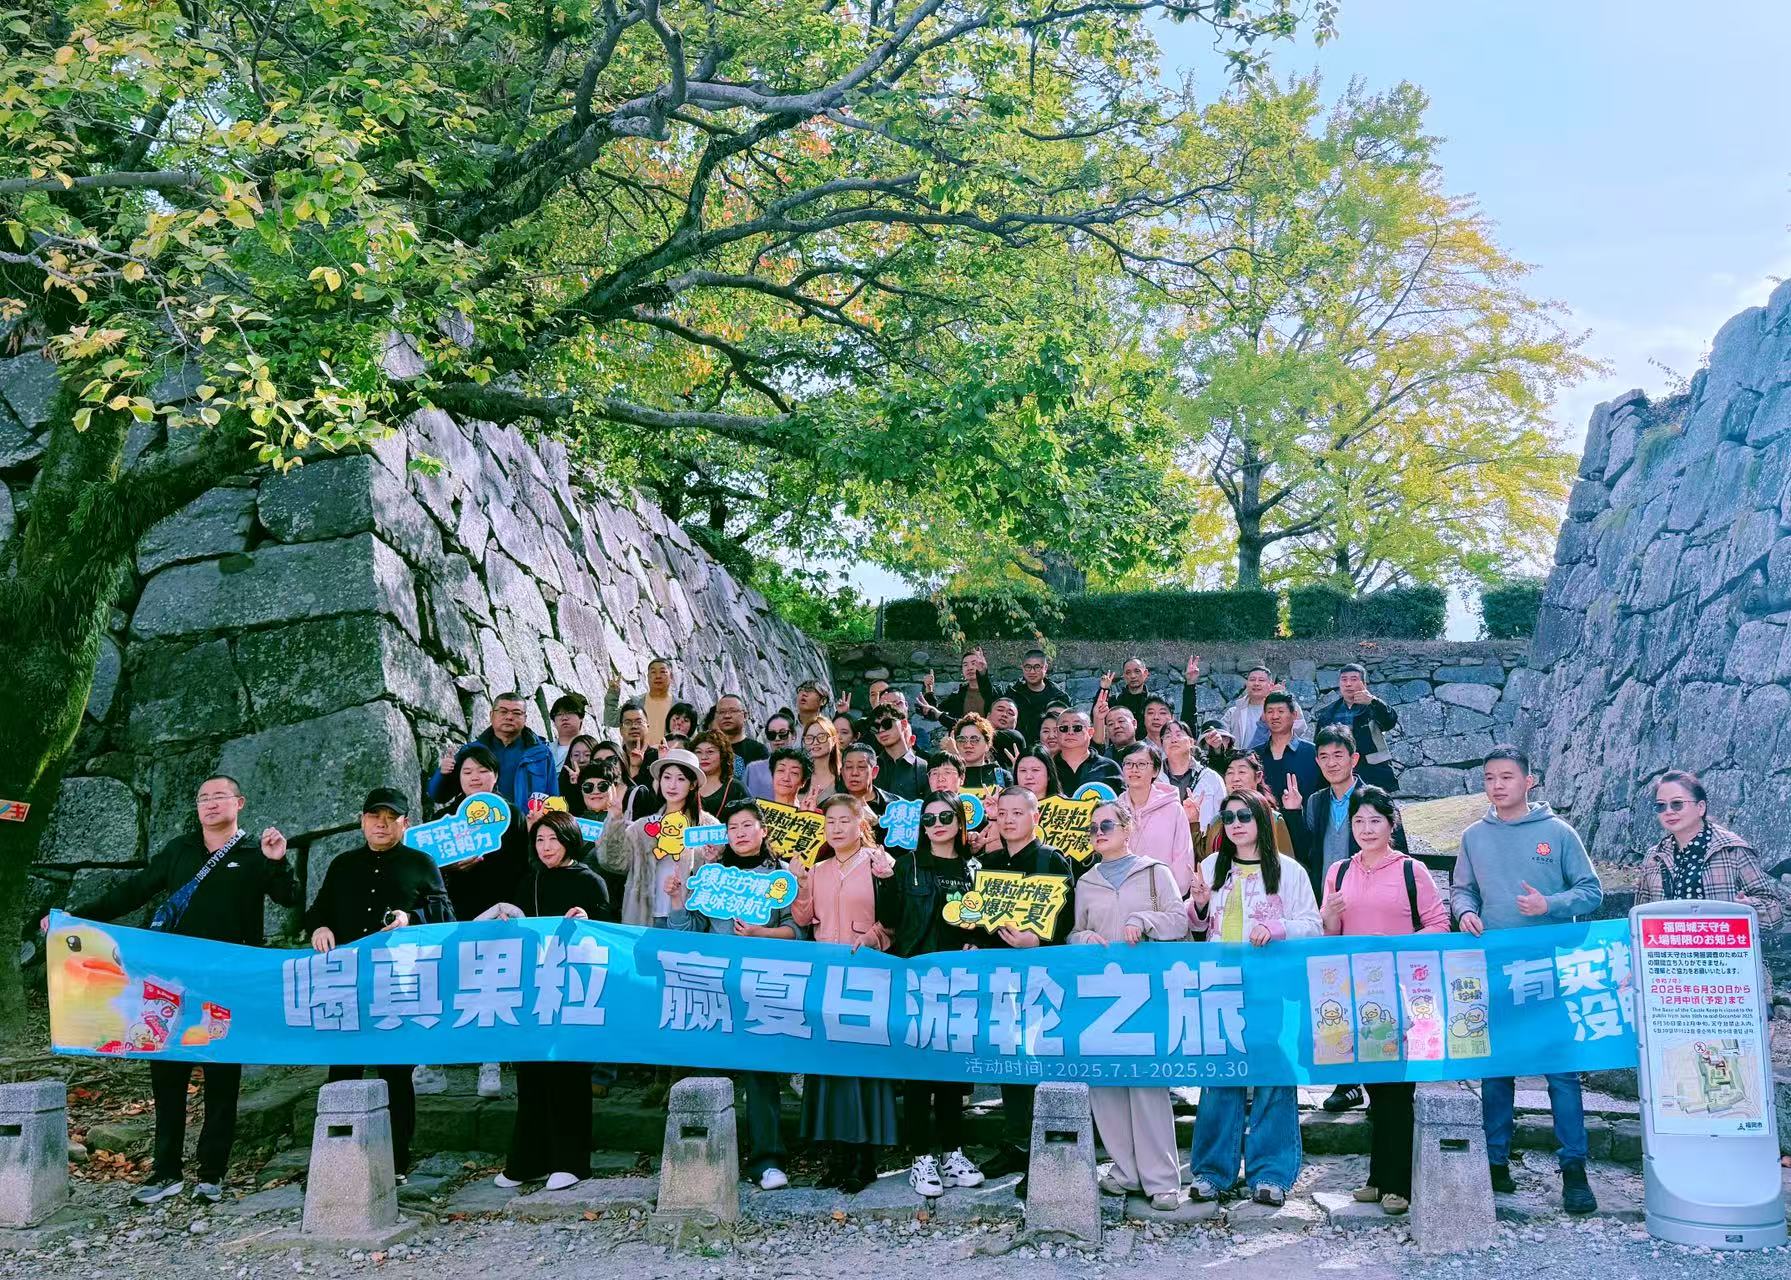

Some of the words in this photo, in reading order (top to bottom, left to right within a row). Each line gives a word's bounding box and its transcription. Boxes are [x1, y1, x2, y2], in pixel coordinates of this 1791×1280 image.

[767, 826, 820, 860] 爽一夏!
[980, 878, 1053, 903] 爆粒柠檬
[1663, 922, 1730, 933] 福岡城天守台
[1647, 934, 1747, 945] 入場制限のお知らせ
[282, 935, 609, 1031] 喝真果粒
[657, 950, 1247, 1055] 赢夏日游轮之旅
[1651, 985, 1751, 994] 2025年6月30日から
